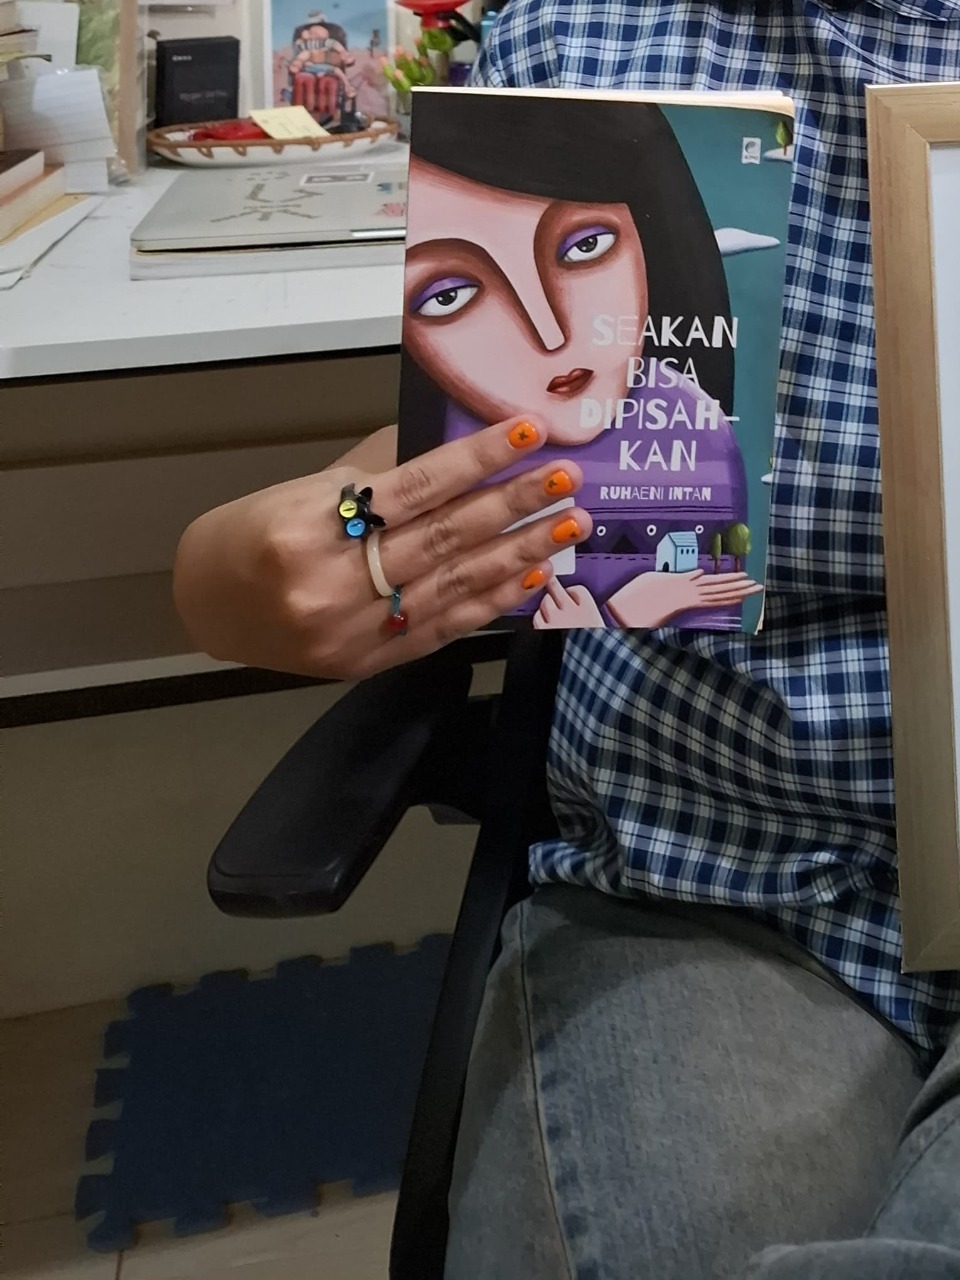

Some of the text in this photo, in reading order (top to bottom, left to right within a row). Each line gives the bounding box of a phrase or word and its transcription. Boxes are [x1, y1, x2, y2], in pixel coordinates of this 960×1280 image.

[592, 314, 739, 348] SEAKAN
[627, 357, 701, 389] BISA
[579, 398, 740, 430] DIPISAH-
[619, 439, 697, 472] KAN
[600, 486, 712, 501] RUHAENI INTAN
